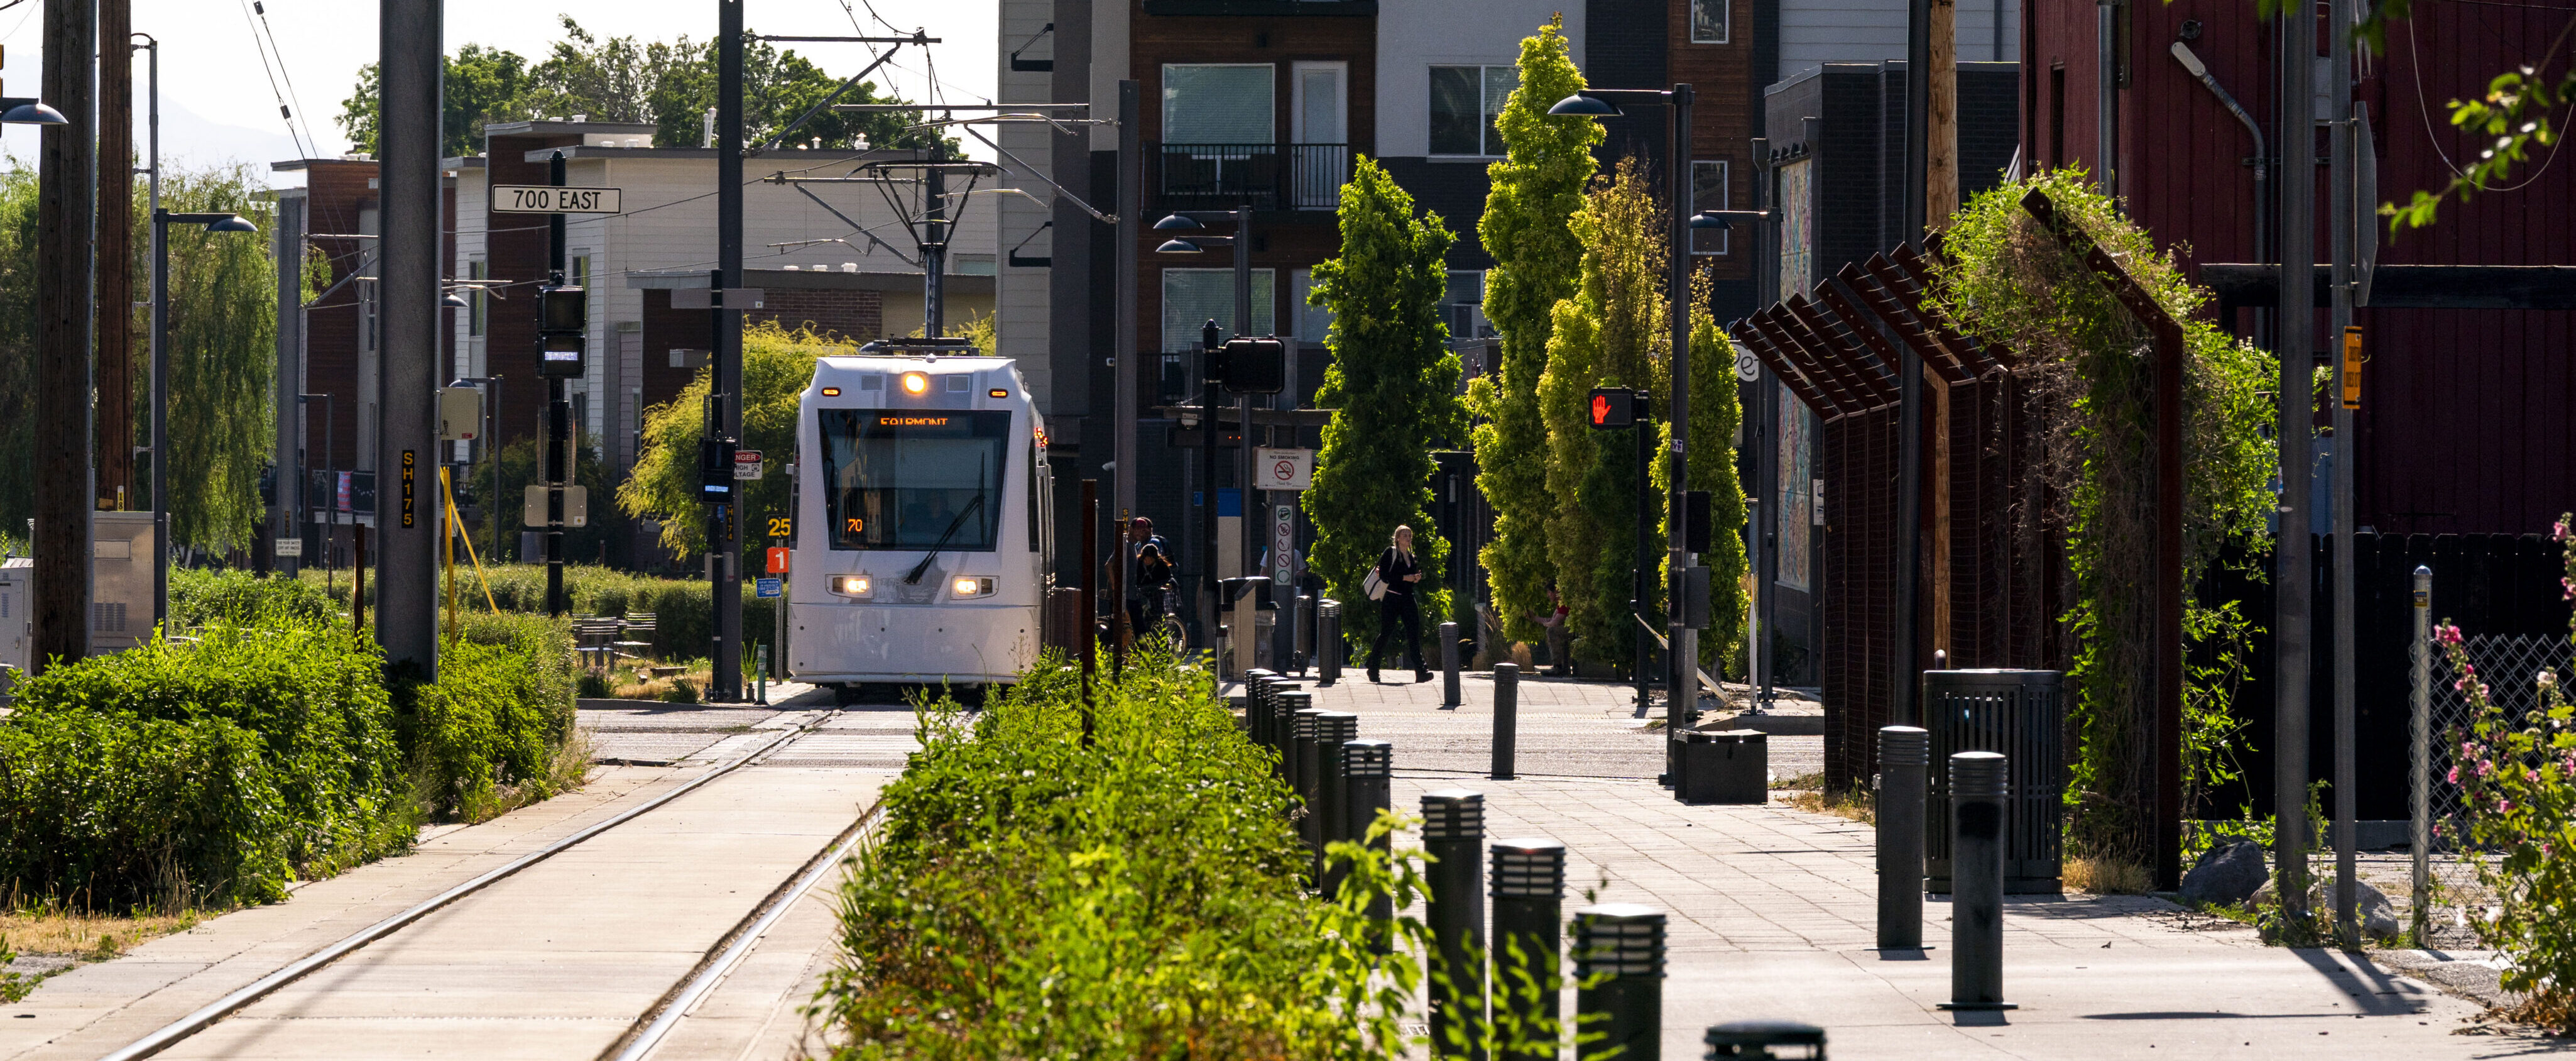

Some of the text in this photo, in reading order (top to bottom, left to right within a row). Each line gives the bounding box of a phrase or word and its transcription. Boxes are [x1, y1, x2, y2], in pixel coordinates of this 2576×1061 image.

[513, 190, 601, 209] 700 EAST
[402, 452, 413, 525] SH175
[768, 518, 790, 536] 25
[848, 519, 863, 532] 70
[775, 551, 784, 569] 1
